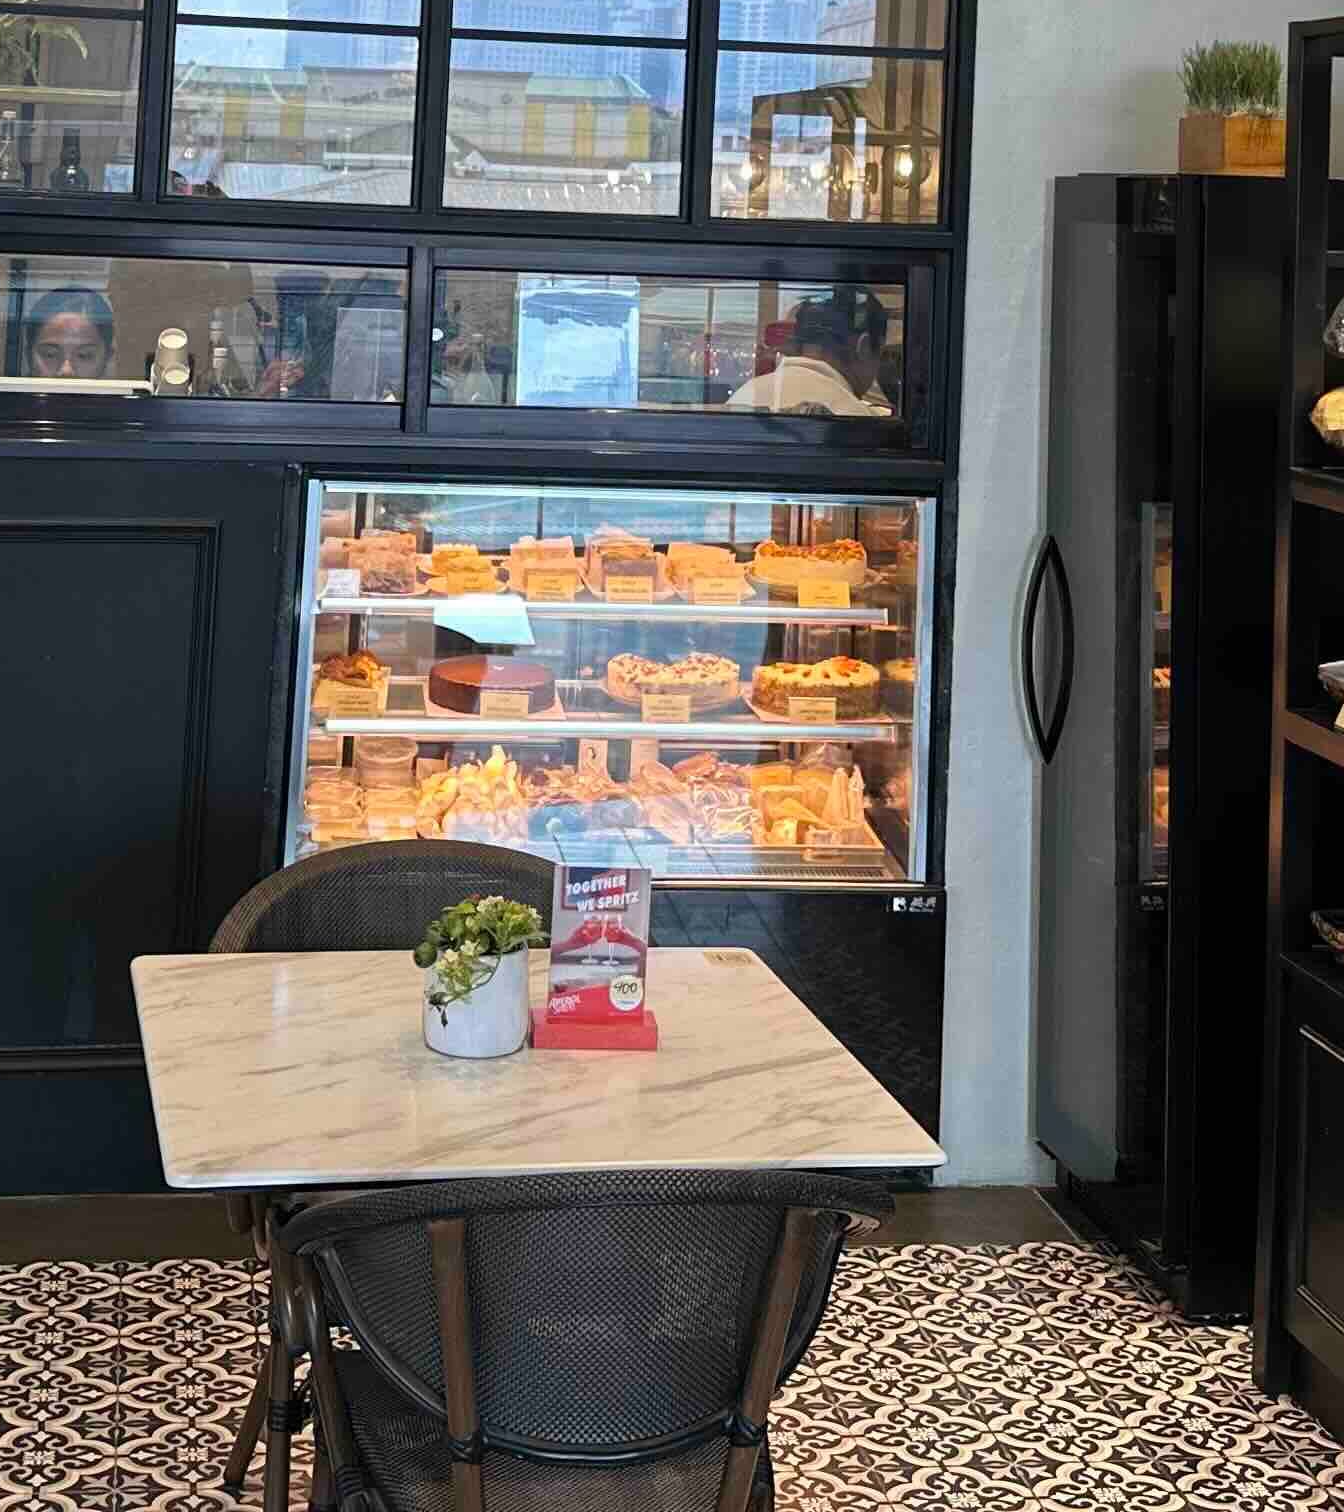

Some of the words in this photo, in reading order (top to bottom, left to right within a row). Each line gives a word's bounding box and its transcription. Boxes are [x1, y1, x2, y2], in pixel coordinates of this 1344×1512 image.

[566, 874, 626, 896] TOGETHER
[576, 897, 595, 912] WE
[598, 890, 640, 909] SPRITZ
